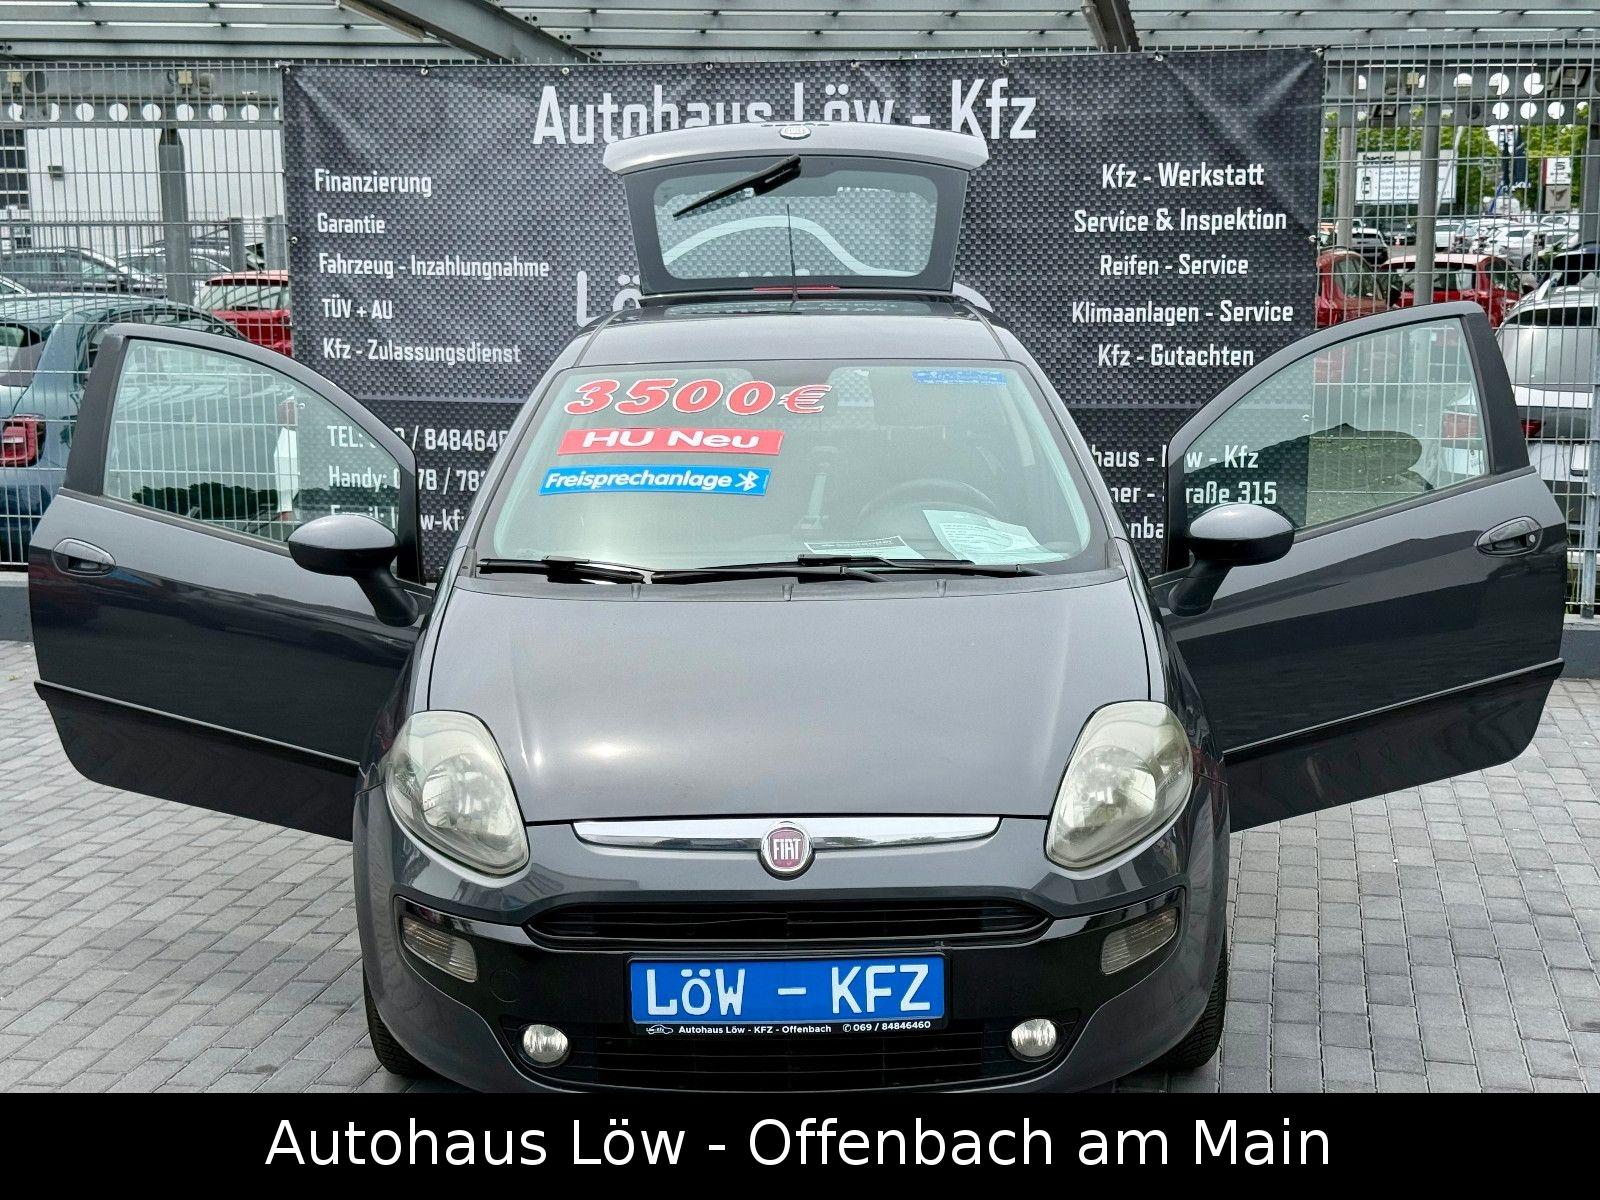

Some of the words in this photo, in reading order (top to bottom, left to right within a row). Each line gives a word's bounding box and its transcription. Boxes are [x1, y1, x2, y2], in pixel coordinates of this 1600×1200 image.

[533, 84, 772, 144] Autohaus
[911, 115, 931, 124] -
[951, 78, 1037, 140] Kfz
[314, 168, 432, 198] Finanzierung
[1102, 163, 1137, 188] Kfz
[1158, 162, 1265, 187] Werkstatt
[317, 212, 386, 235] Garantie
[1074, 209, 1149, 232] Service
[1156, 207, 1174, 231] &
[1180, 207, 1287, 235] Inspektion
[319, 252, 394, 278] Fahrzeug
[411, 254, 550, 280] Inzahlungnahme
[1100, 255, 1159, 275] Reifen
[1178, 254, 1249, 275] Service
[321, 293, 352, 319] TÜV
[356, 307, 368, 318] +
[372, 299, 393, 319] AU
[1072, 301, 1199, 326] Klimaanlagen
[1220, 300, 1294, 322] Service
[323, 338, 351, 359] Kfz
[368, 339, 522, 365] Zulassungsdienst
[1098, 344, 1131, 367] Kfz
[1150, 343, 1254, 367] Gutachten
[564, 378, 832, 416] 3500€
[327, 425, 364, 448] TEL:
[424, 428, 508, 452] 848464
[582, 430, 654, 448] HU
[667, 430, 760, 448] Neu
[1224, 445, 1259, 469] Kfz
[328, 465, 388, 493] Handy:
[545, 469, 733, 490] Freisprechanlage
[1237, 481, 1277, 505] 315
[773, 838, 802, 860] FIAT
[777, 987, 807, 995] -
[831, 964, 931, 1014] KFZ
[678, 1026, 724, 1034] Autohaus
[725, 1026, 745, 1034] Löw
[754, 1026, 773, 1034] KFZ
[781, 1025, 832, 1033] Offenbach
[853, 1023, 873, 1032] 069
[881, 1020, 931, 1031] 84846460
